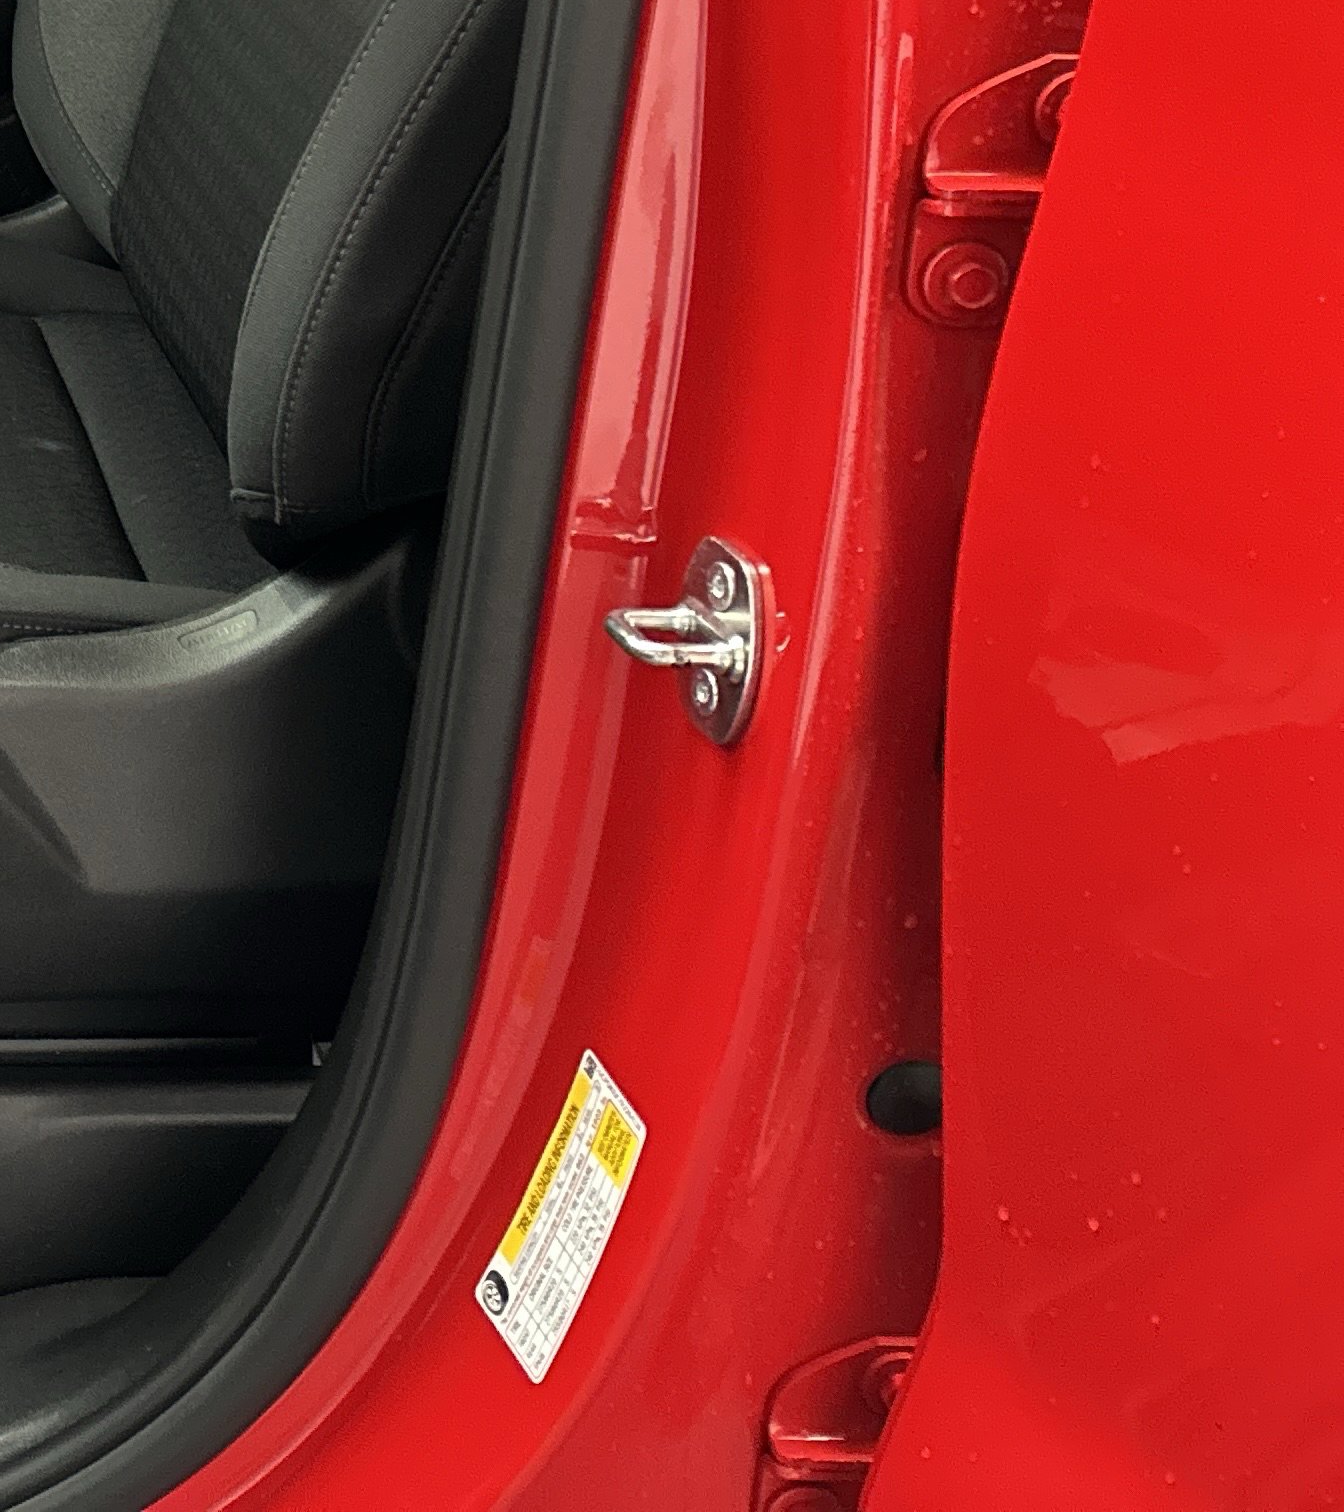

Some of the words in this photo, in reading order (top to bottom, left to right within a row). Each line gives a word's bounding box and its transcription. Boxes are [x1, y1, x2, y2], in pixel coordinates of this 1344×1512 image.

[517, 1212, 531, 1236] TIRE
[527, 1195, 540, 1216] AND
[535, 1158, 557, 1199] LOADING
[552, 1104, 580, 1162] INFORMATION
